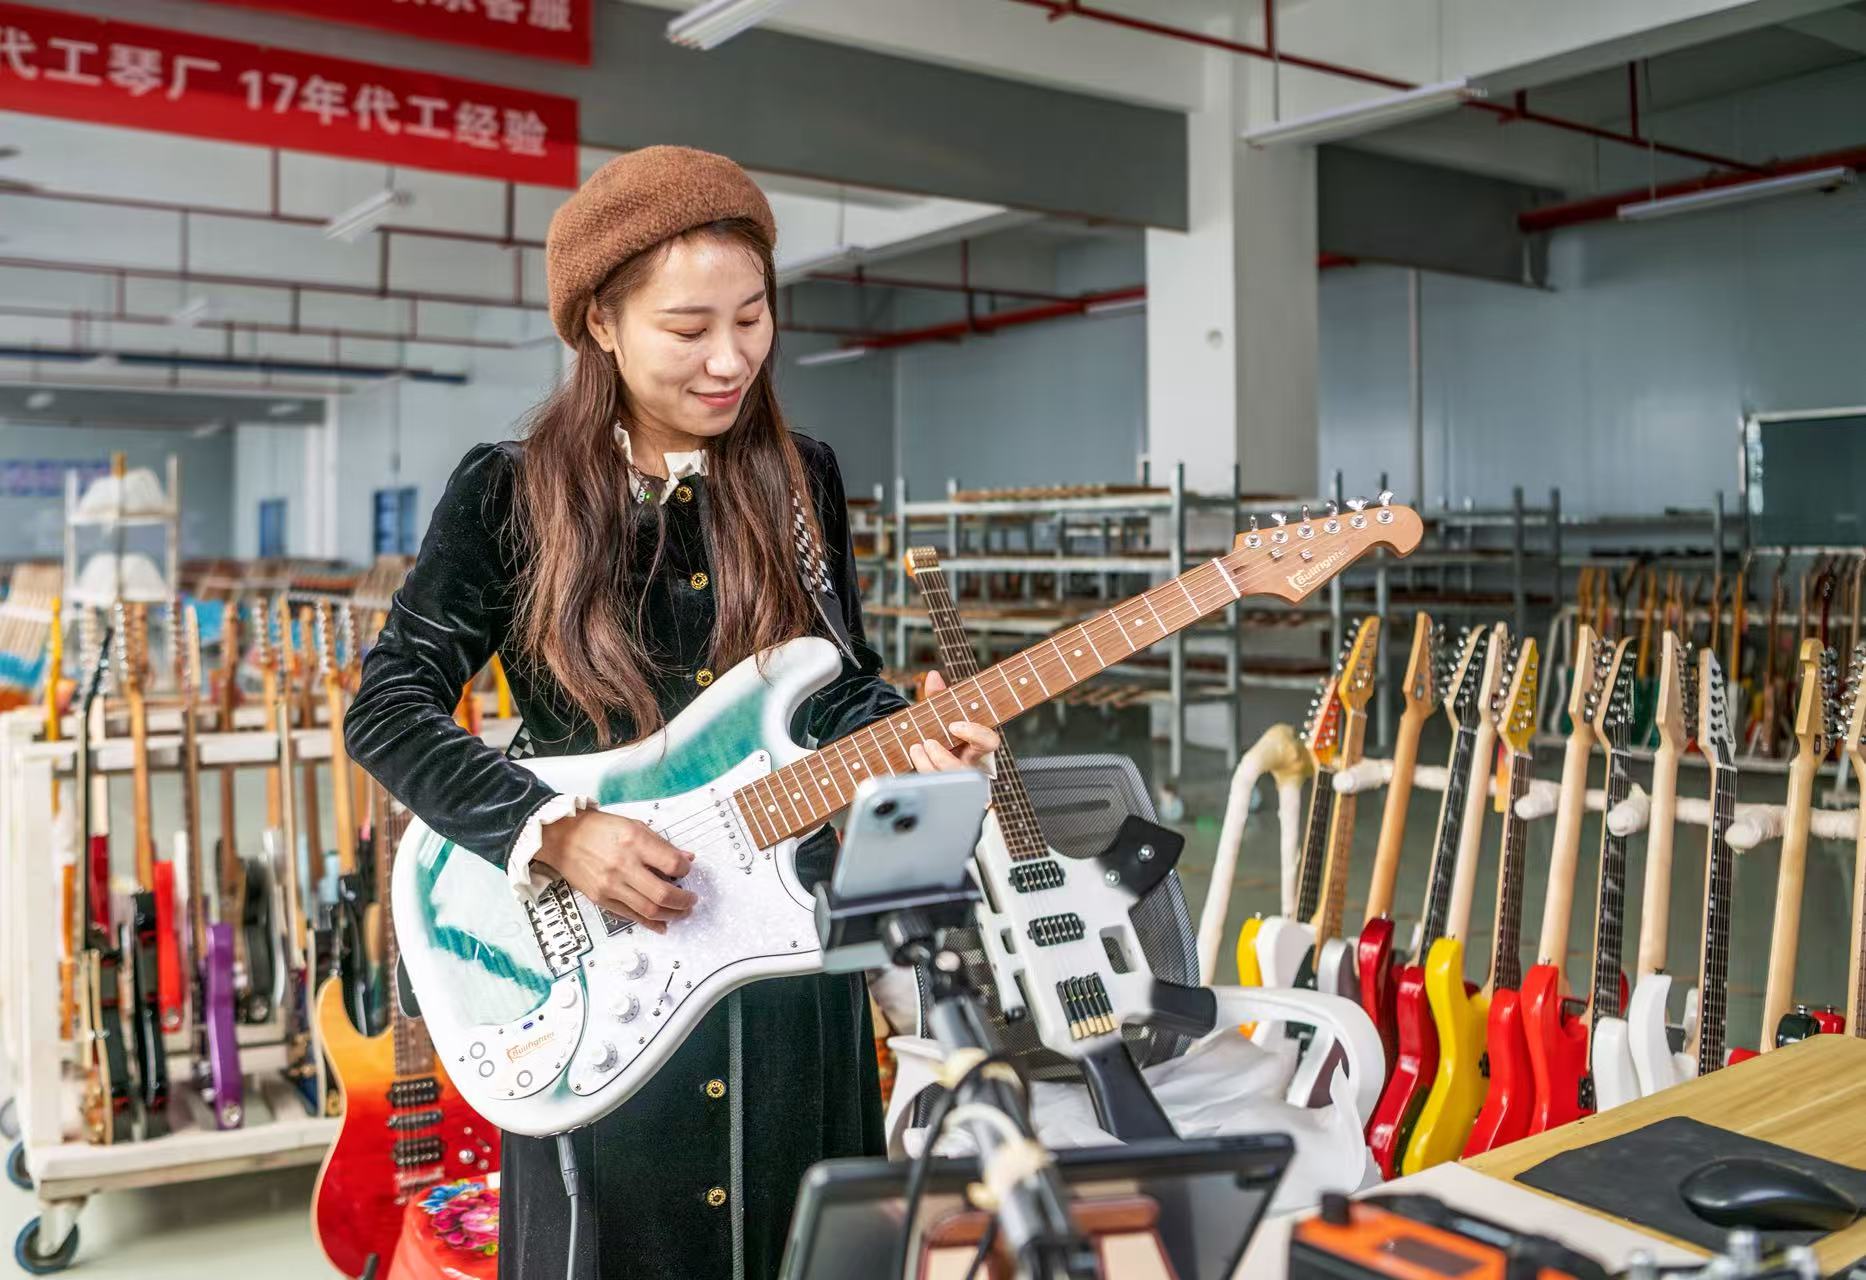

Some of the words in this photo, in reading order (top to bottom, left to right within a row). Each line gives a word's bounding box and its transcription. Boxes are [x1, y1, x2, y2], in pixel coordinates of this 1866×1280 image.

[0, 26, 221, 101] 代工琴厂
[239, 69, 548, 157] 17年代工经验
